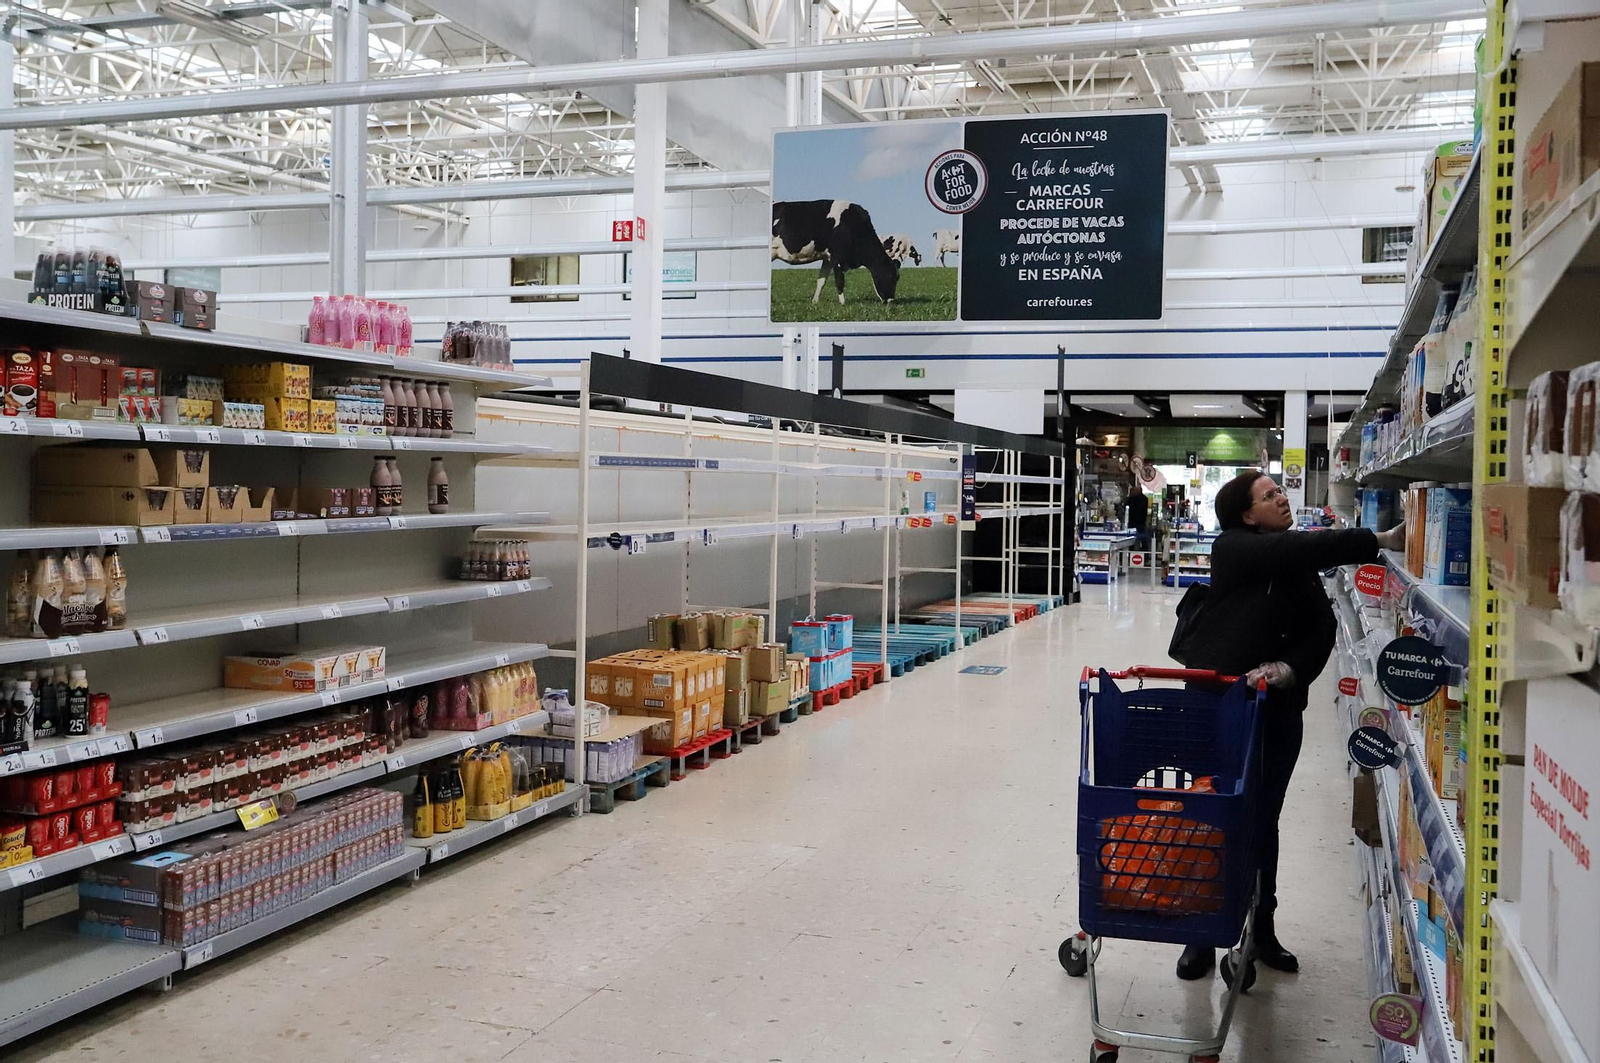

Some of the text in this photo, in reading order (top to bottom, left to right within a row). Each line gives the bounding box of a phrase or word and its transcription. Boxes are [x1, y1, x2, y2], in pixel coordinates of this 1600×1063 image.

[1020, 128, 1071, 144] ACCIÓN
[934, 154, 953, 169] ACCIONES
[1011, 159, 1115, 180] La leche de nuestras
[945, 174, 966, 190] FOR
[945, 184, 972, 201] FOOD
[1029, 184, 1091, 197] MARCAS
[945, 197, 977, 212] COMER MEJOR
[1016, 197, 1104, 211] CARREFOUR
[1000, 216, 1124, 230] PROCEDE DE VACAS
[1017, 230, 1106, 245] AUTÓCTONAS
[1000, 246, 1123, 267] y se produce y se envasa
[1018, 265, 1103, 281] EN ESPAÑA
[48, 293, 95, 310] PROTEIN
[105, 303, 125, 314] PROTEIN
[1026, 296, 1093, 307] carrefour.es
[15, 365, 34, 373] TAZA
[1188, 454, 1195, 465] 6
[1319, 457, 1325, 468] 7
[1359, 571, 1382, 581] Super
[1357, 580, 1381, 590] precio
[257, 658, 281, 667] COVAP
[1385, 651, 1427, 664] TU MARCA
[284, 669, 293, 678] 50
[1387, 665, 1436, 681] Carrefour
[294, 681, 303, 689] 95
[1357, 730, 1384, 749] TU MARCA
[1355, 739, 1386, 760] Carrefour
[1533, 743, 1589, 821] PAN DE MOLDE
[57, 817, 66, 839] nocilla
[1530, 781, 1591, 871] Especial Torrijas
